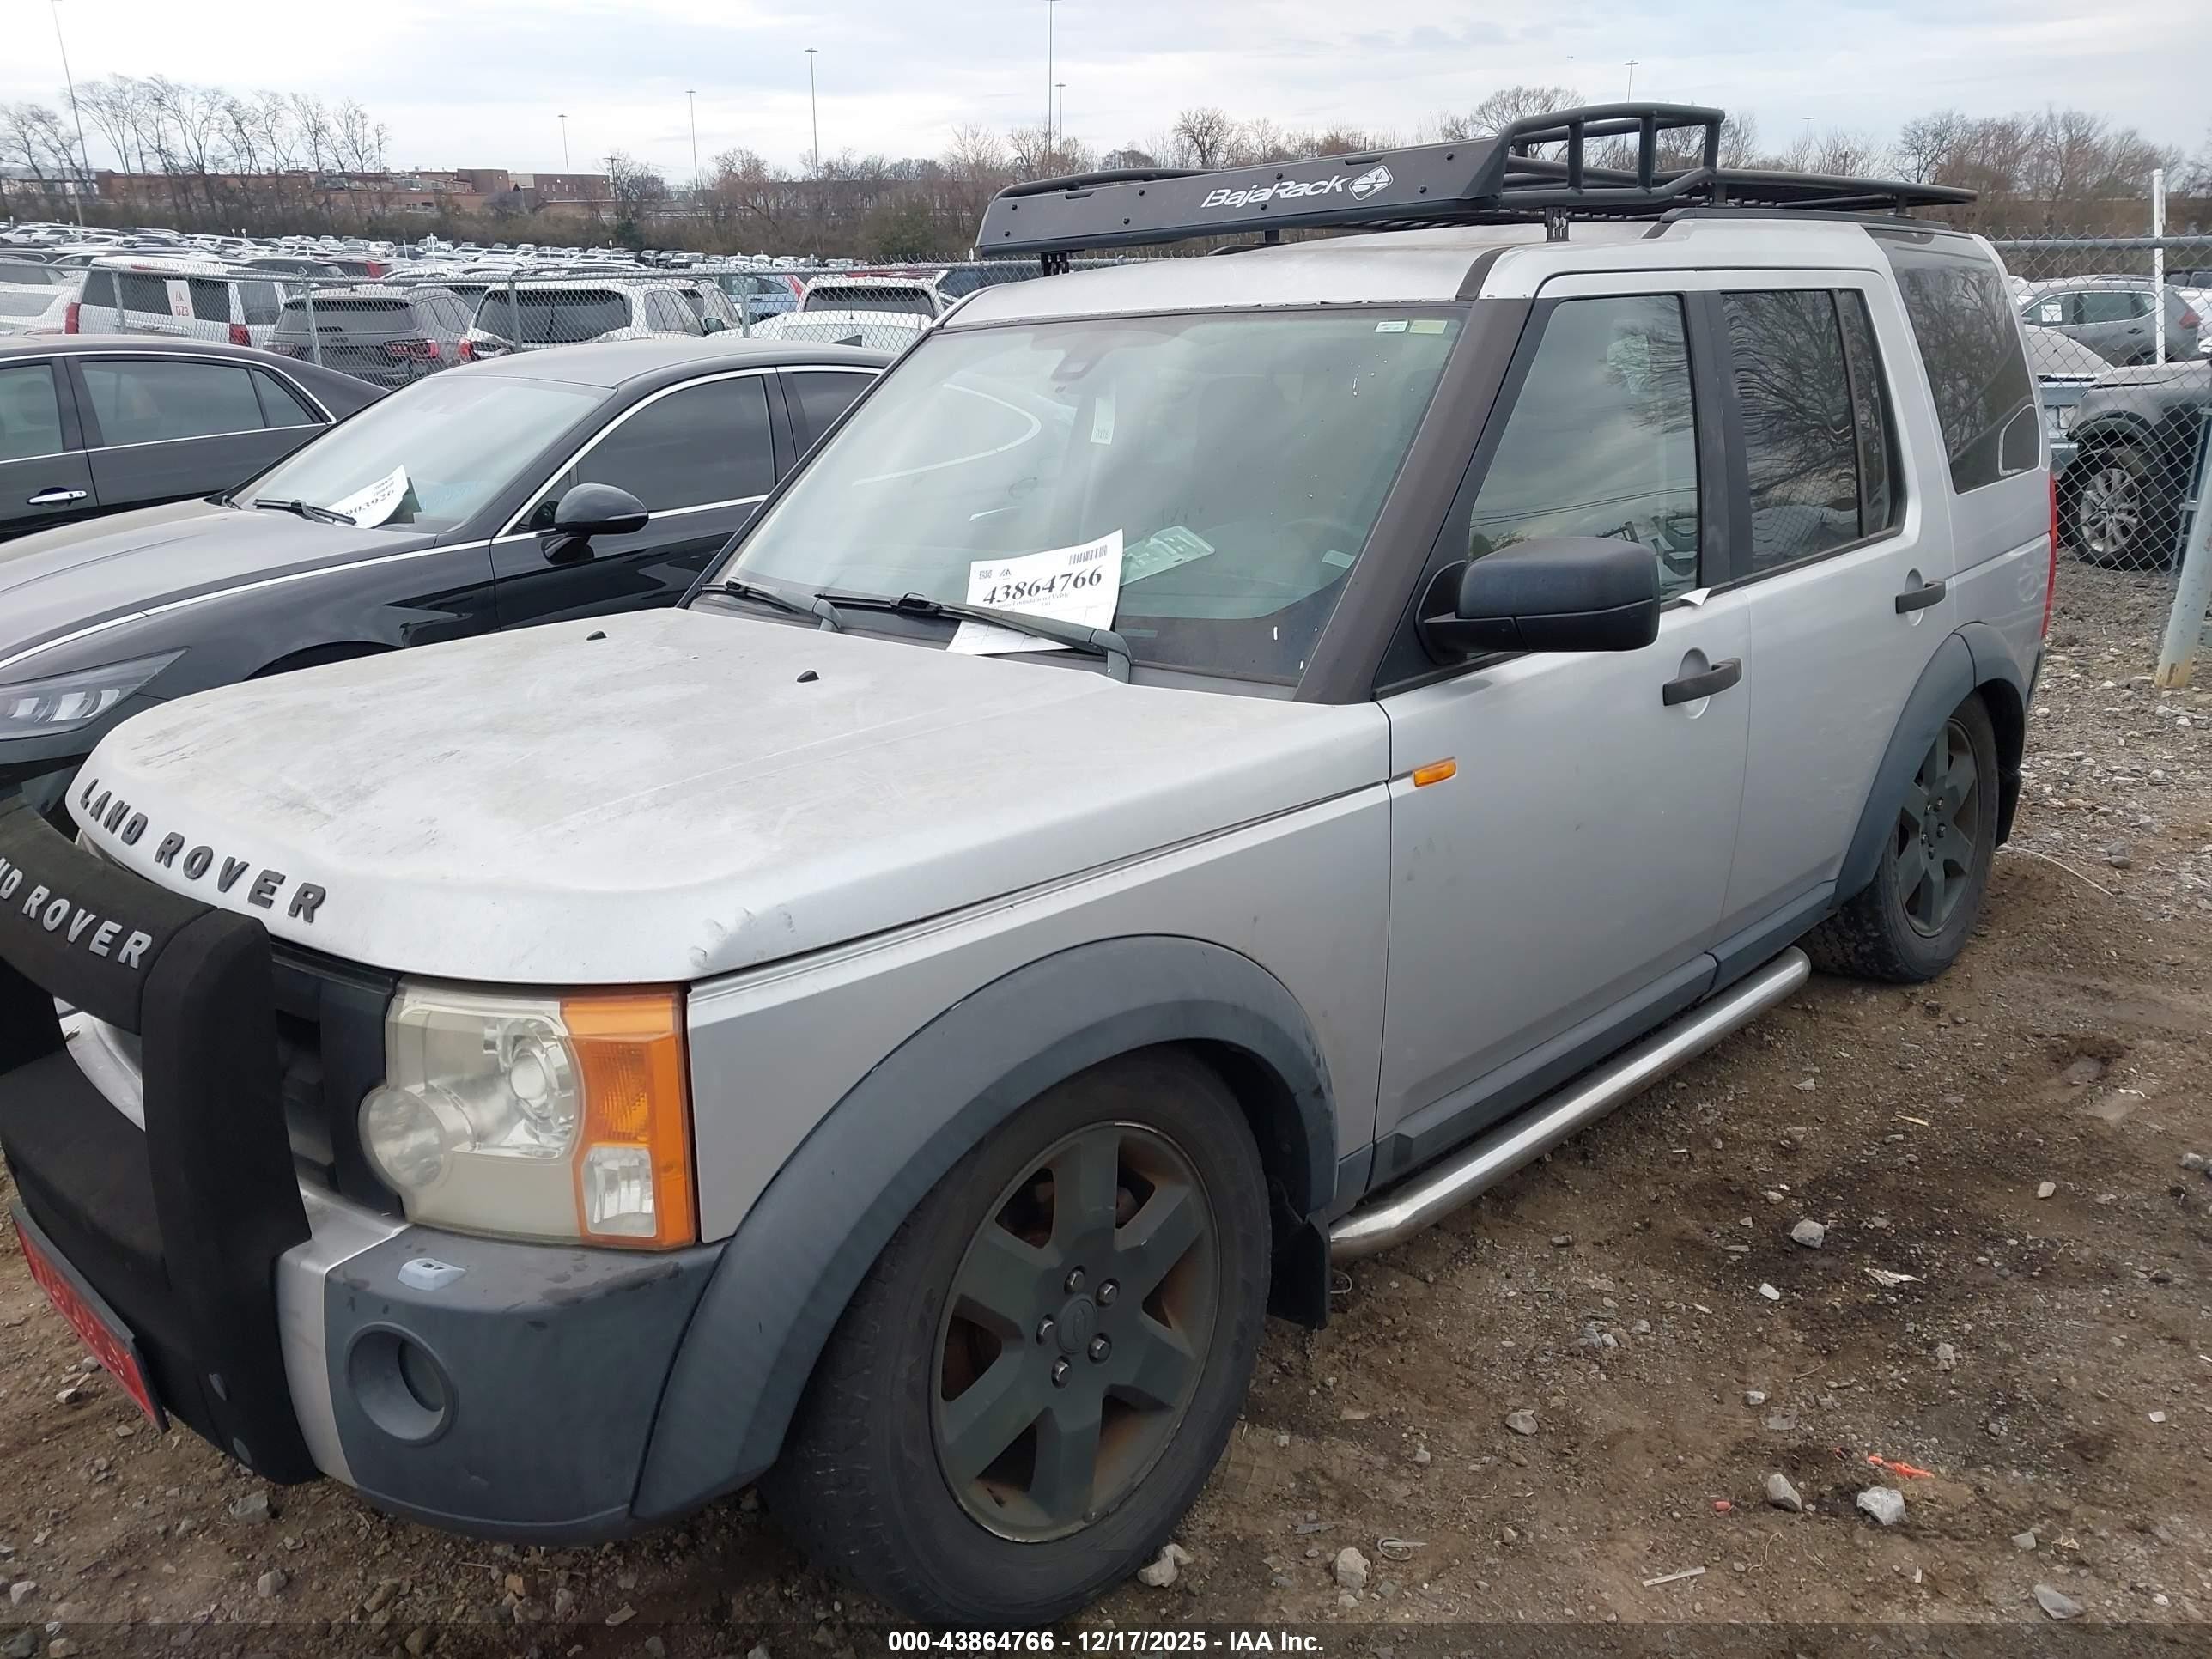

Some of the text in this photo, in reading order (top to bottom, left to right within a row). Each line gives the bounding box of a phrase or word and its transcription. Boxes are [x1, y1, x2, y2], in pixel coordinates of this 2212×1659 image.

[1200, 175, 1351, 208] BajaRack
[175, 305, 190, 317] DZ3
[983, 564, 1103, 604] 43864766
[80, 778, 326, 923] LAND ROVER
[21, 884, 153, 969] ROVER
